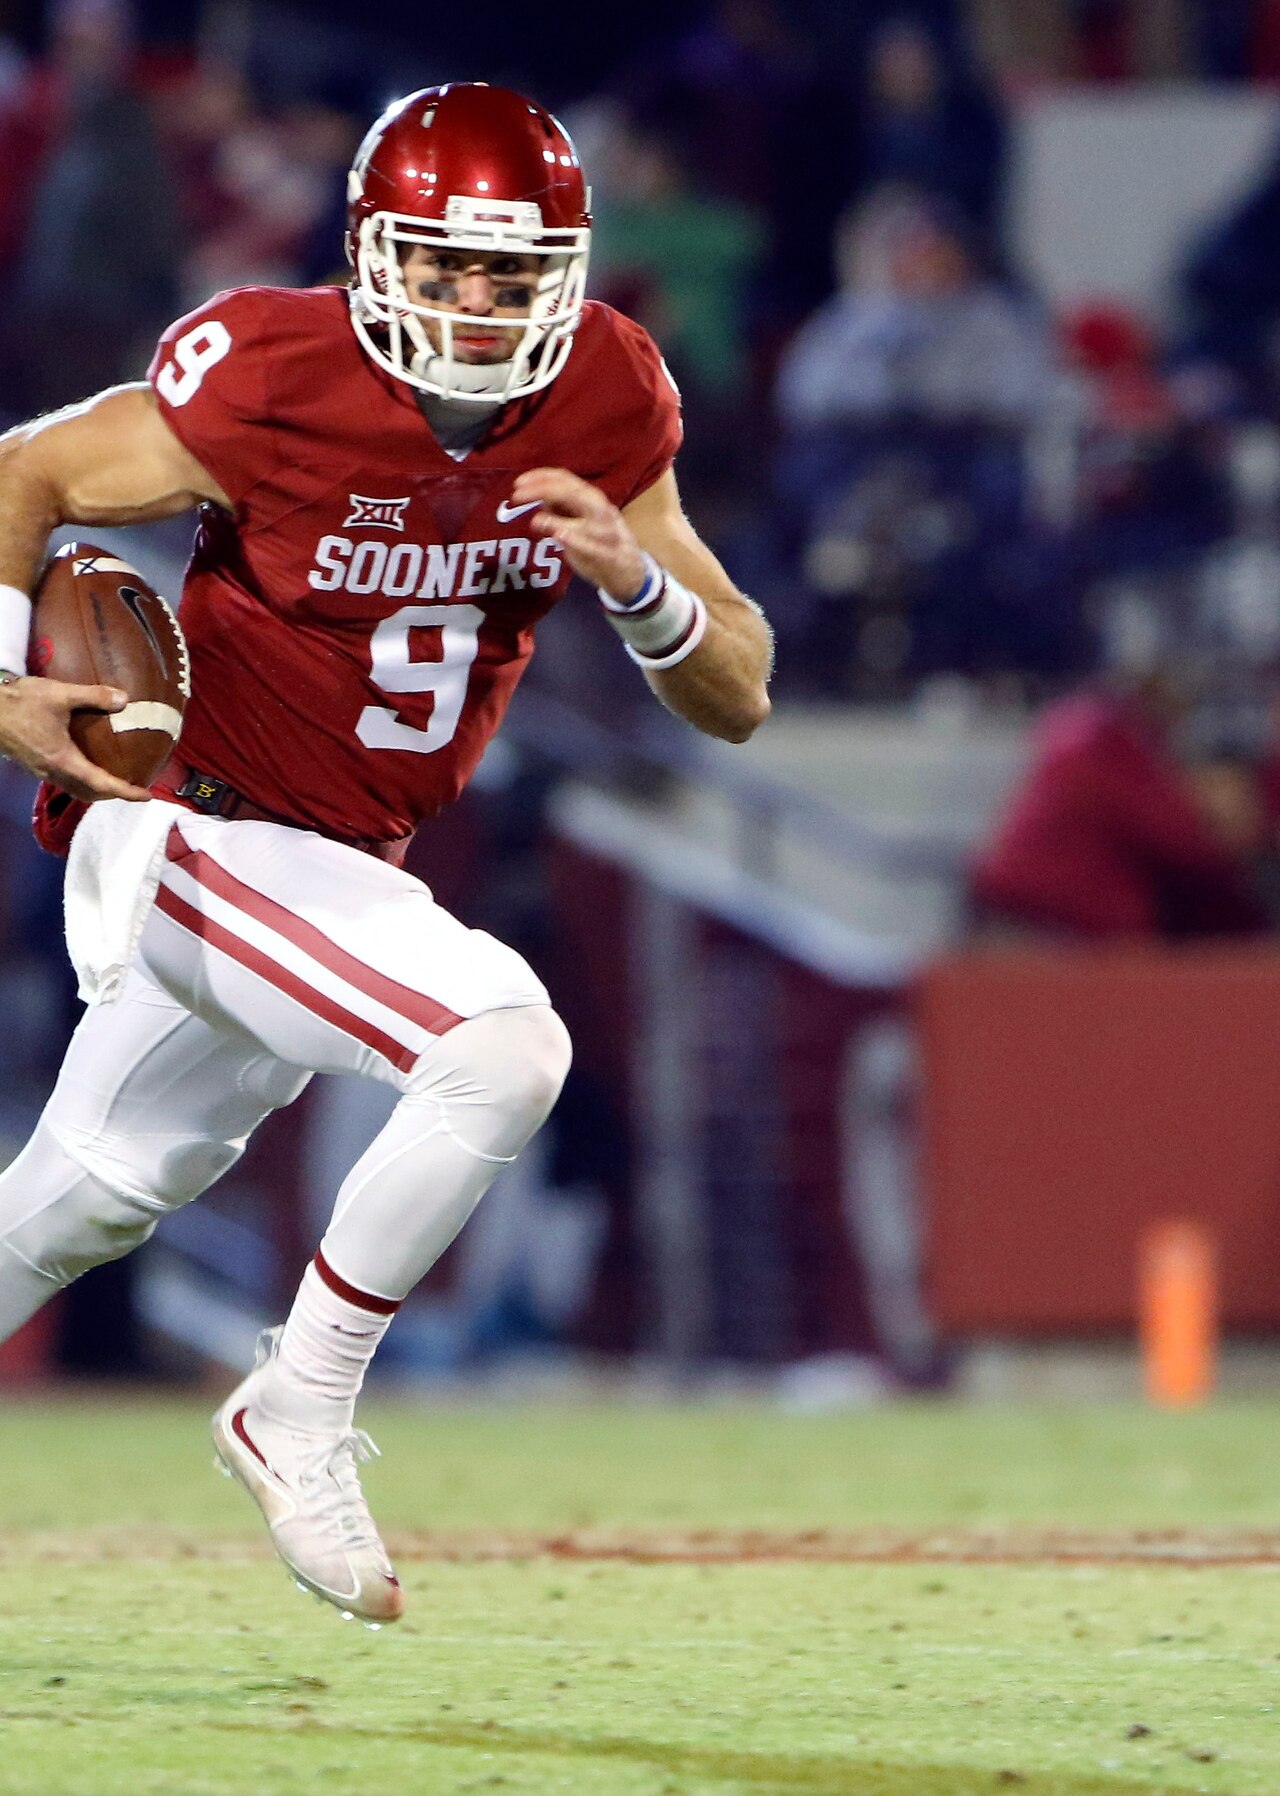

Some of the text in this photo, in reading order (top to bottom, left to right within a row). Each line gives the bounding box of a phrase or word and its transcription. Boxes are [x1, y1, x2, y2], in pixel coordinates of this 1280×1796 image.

[156, 321, 232, 406] 9
[308, 535, 564, 598] SOONERS
[354, 603, 485, 753] 9
